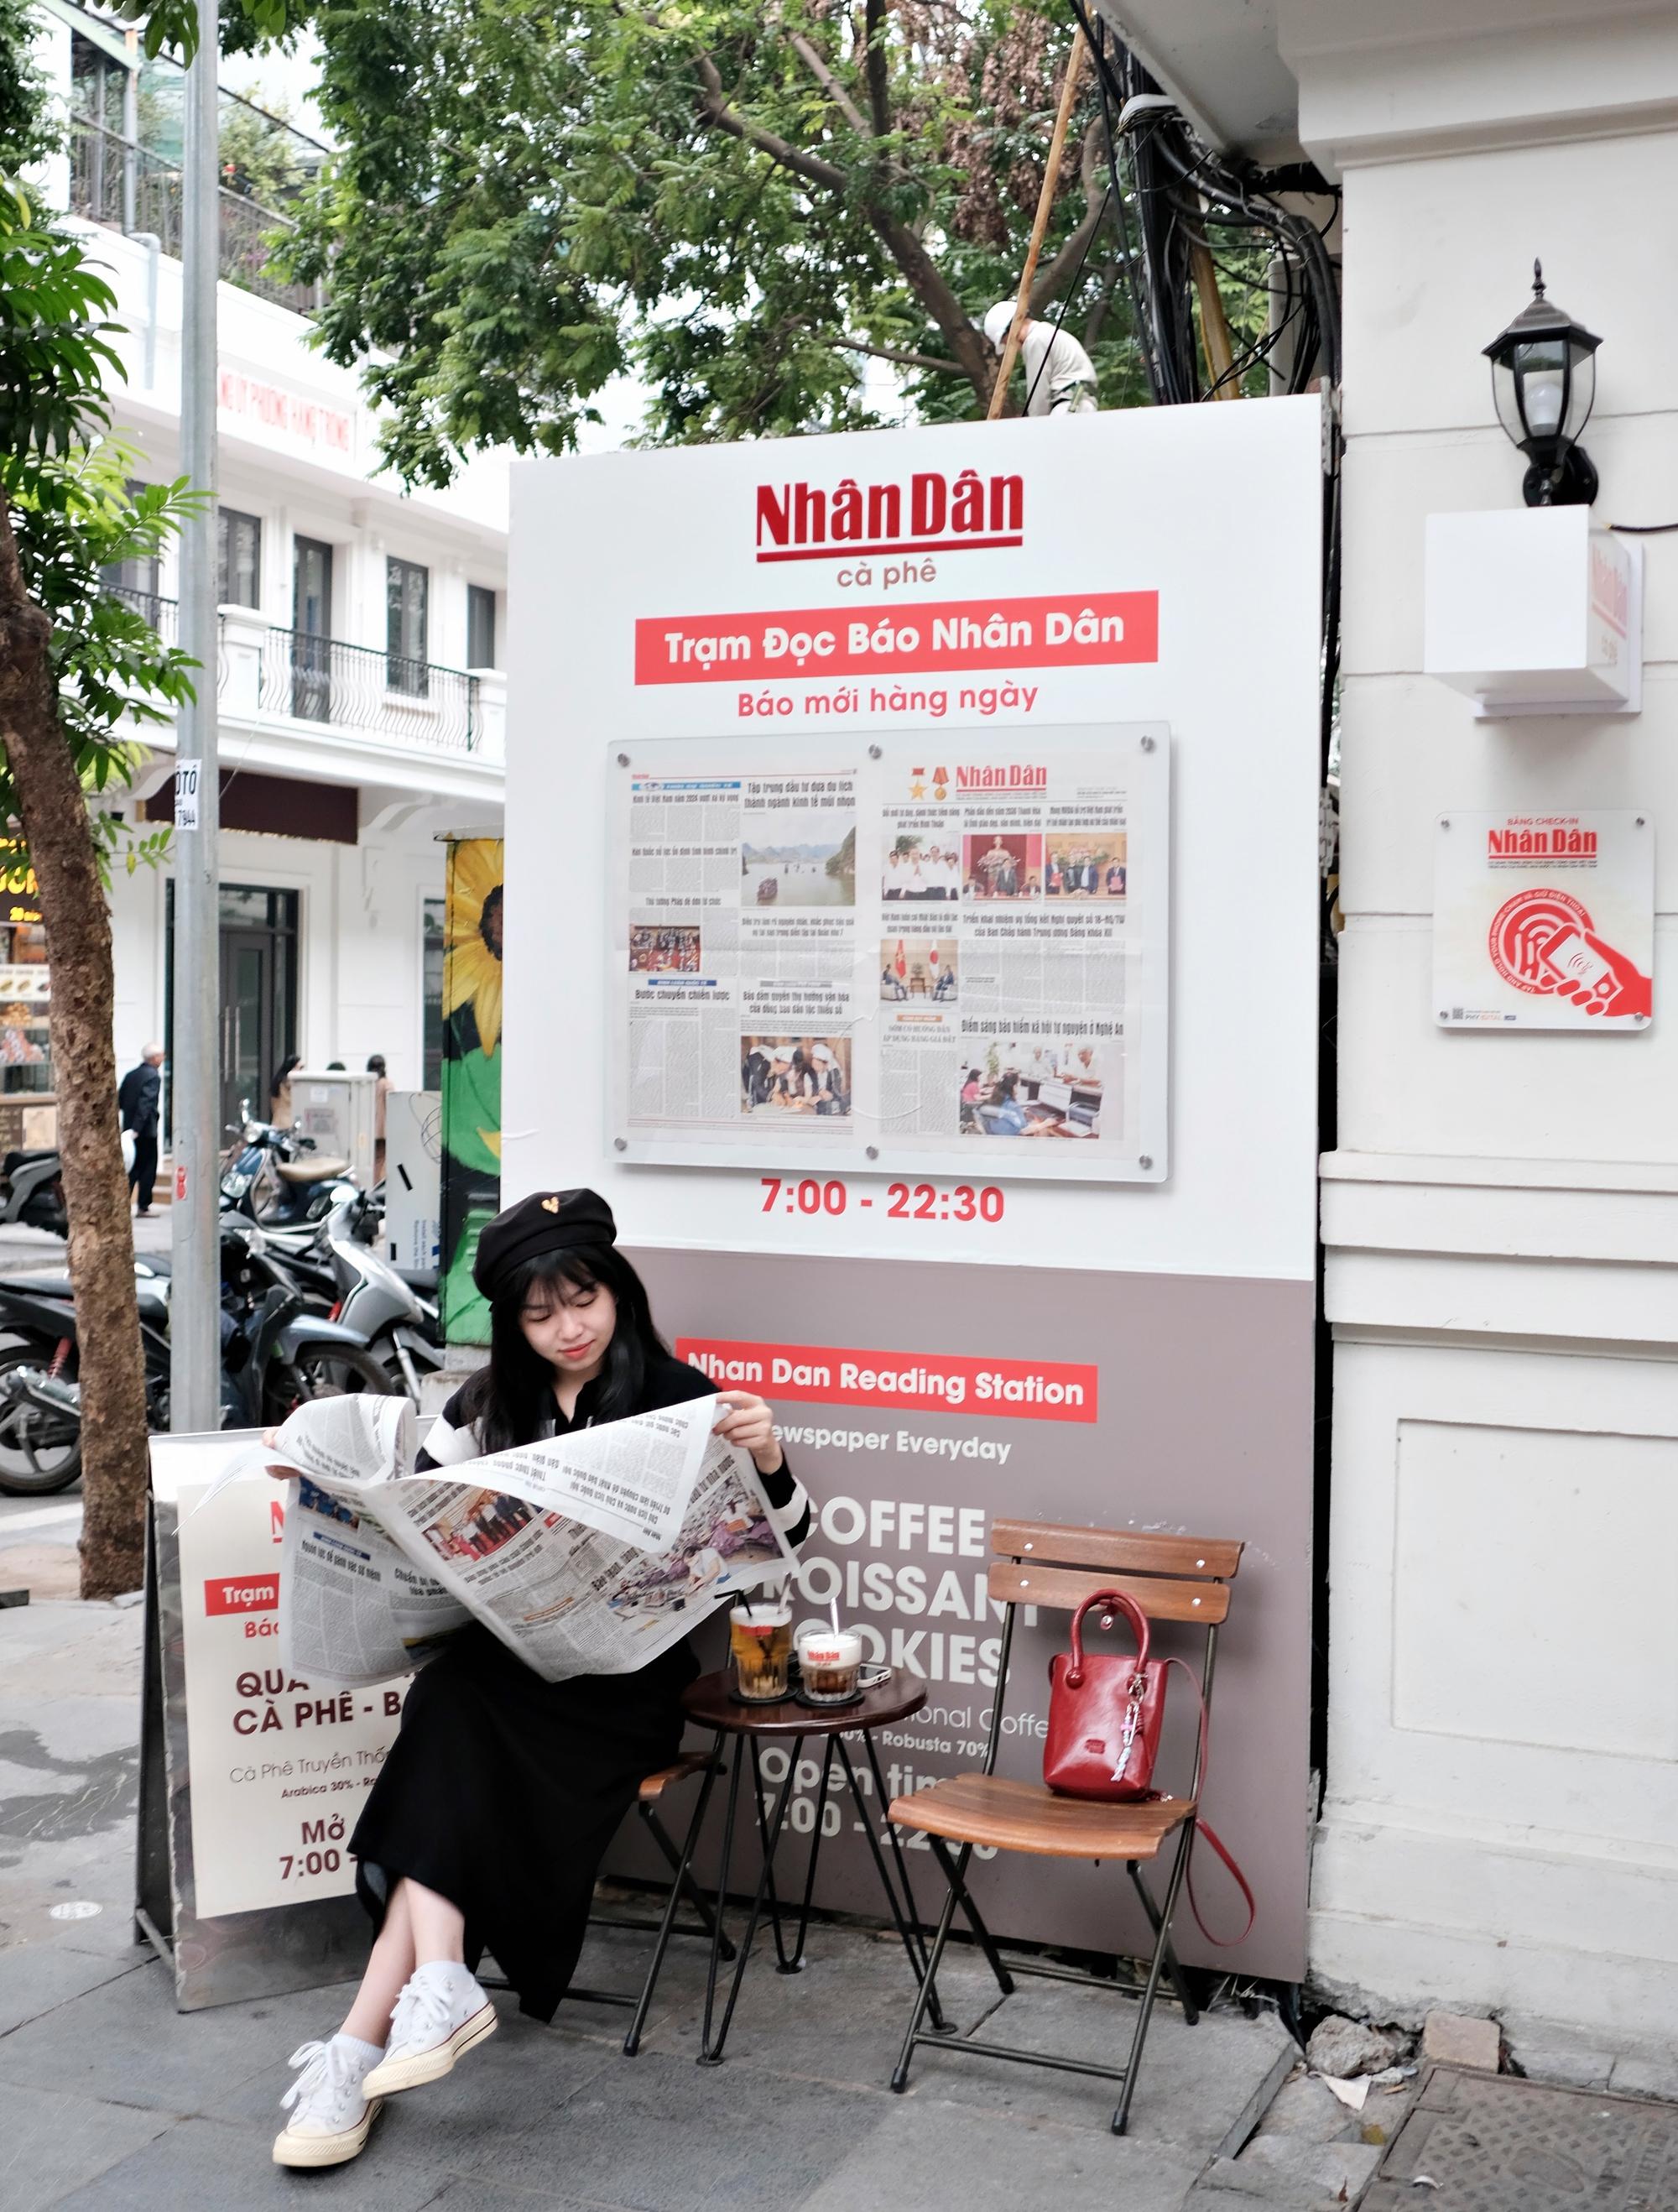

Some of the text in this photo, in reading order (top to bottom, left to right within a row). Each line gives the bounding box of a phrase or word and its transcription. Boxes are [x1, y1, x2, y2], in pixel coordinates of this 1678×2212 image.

[757, 469, 1023, 546] Nhân Dân
[837, 558, 936, 590] cà phê
[664, 608, 1124, 670] Trạm Đọc Báo Nhân Dân
[737, 679, 1039, 717] Báo mới hàng ngày
[956, 764, 1047, 787] Nhân Dân
[1488, 828, 1597, 853] Nhân Dân
[761, 1177, 847, 1216] 7:00
[887, 1182, 1004, 1223] 22:30
[772, 1358, 830, 1388] Dan
[840, 1363, 966, 1405] Reading
[975, 1371, 1084, 1406] Station
[771, 1424, 1012, 1464] ewspaper Everyday
[222, 1586, 275, 1607] Trạm
[233, 1698, 284, 1735] CÀ
[295, 1690, 354, 1729] PHÊ
[383, 1690, 401, 1717] B
[883, 1730, 951, 1755] Robusta
[229, 1745, 390, 1784] Cà Phê Truyền Thố
[758, 1746, 873, 1796] Open
[281, 1784, 327, 1798] Arabica
[331, 1779, 354, 1792] 30%
[301, 1813, 345, 1844] Mở
[755, 1792, 842, 1838] 7:00
[279, 1849, 341, 1881] 7:00
